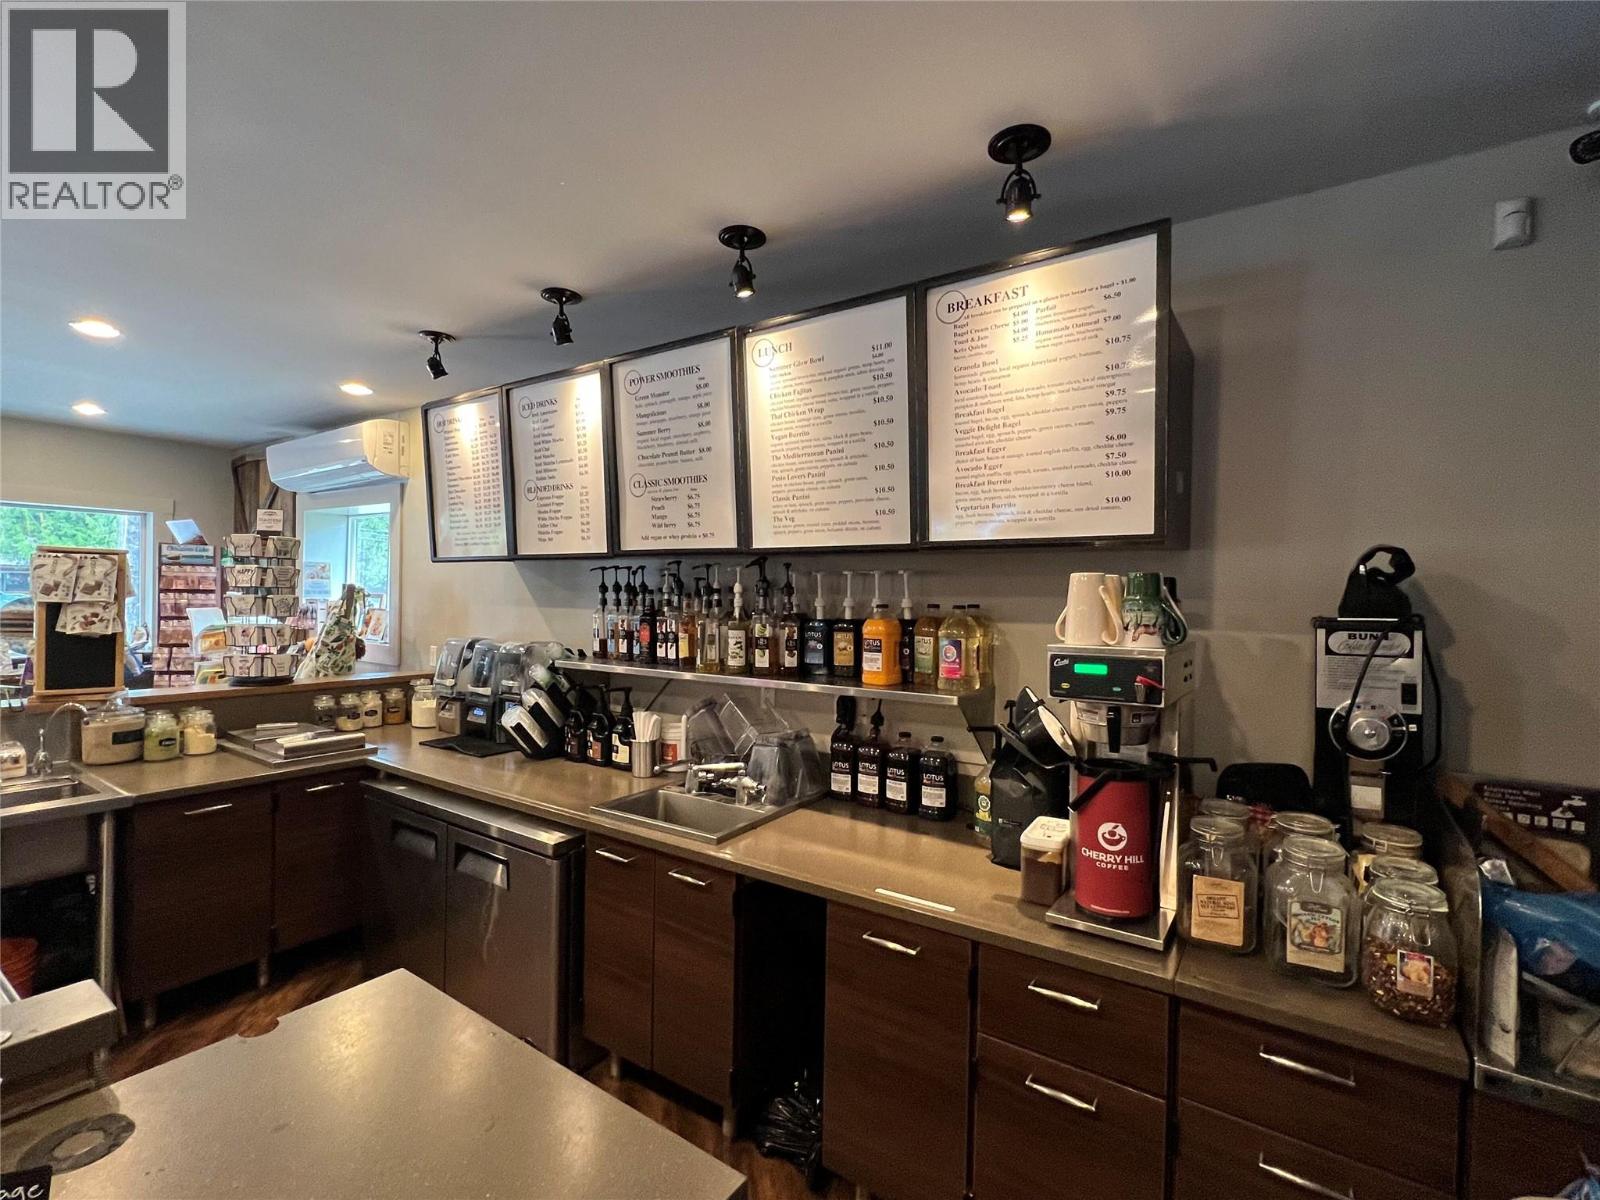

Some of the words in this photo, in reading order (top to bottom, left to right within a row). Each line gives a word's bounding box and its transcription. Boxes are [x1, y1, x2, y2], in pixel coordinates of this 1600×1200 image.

[947, 284, 1029, 314] BREAKFAST
[1103, 291, 1122, 300] $6.50
[1072, 318, 1100, 329] Oatmeal
[1103, 314, 1122, 324] $7.00
[954, 321, 969, 330] Bagel
[954, 330, 969, 339] Bagel
[1104, 334, 1132, 346] $10.75
[871, 341, 893, 352] $11.00
[809, 355, 825, 364] Bowl
[953, 362, 981, 373] Granola
[982, 358, 999, 368] Bowl
[629, 375, 656, 387] POWER
[656, 365, 701, 382] SMOOTHIES
[872, 372, 893, 381] $10.50
[954, 387, 982, 396] Avocado
[1104, 387, 1127, 398] $9.75
[536, 398, 558, 409] DRINKS
[873, 395, 894, 405] $10.50
[783, 410, 806, 419] Chicken
[807, 407, 825, 415] Wrap
[954, 408, 985, 419] Breakfast
[986, 405, 1005, 415] Bagel
[1104, 406, 1127, 416] $9.75
[873, 417, 894, 427] $10.50
[954, 426, 976, 435] Veggie
[977, 423, 1001, 433] Delight
[1002, 419, 1021, 429] Bagel
[1105, 433, 1127, 442] $6.00
[873, 441, 895, 449] $10.50
[783, 450, 824, 459] Mediterranean
[825, 447, 845, 456] Panini
[955, 448, 985, 457] Breakfast
[1105, 452, 1127, 460] $7.50
[874, 463, 895, 472] $10.50
[955, 464, 982, 473] Avocado
[1105, 469, 1132, 478] $10.00
[633, 477, 663, 489] CLASSIC
[664, 474, 708, 486] SMOOTHIES
[955, 479, 986, 489] Breakfast
[987, 478, 1012, 486] Burrito
[553, 483, 574, 491] DRINKS
[874, 486, 895, 494] $10.50
[1105, 495, 1132, 504] $10.00
[875, 508, 896, 516] $10.50
[955, 503, 990, 512] Vegetarian
[859, 761, 877, 770] LOTUS
[887, 767, 905, 776] LOTUS
[923, 773, 944, 781] LOTUS
[1081, 847, 1122, 864] CHERRY
[1124, 855, 1145, 864] HILL
[1096, 861, 1129, 871] COFFEE
